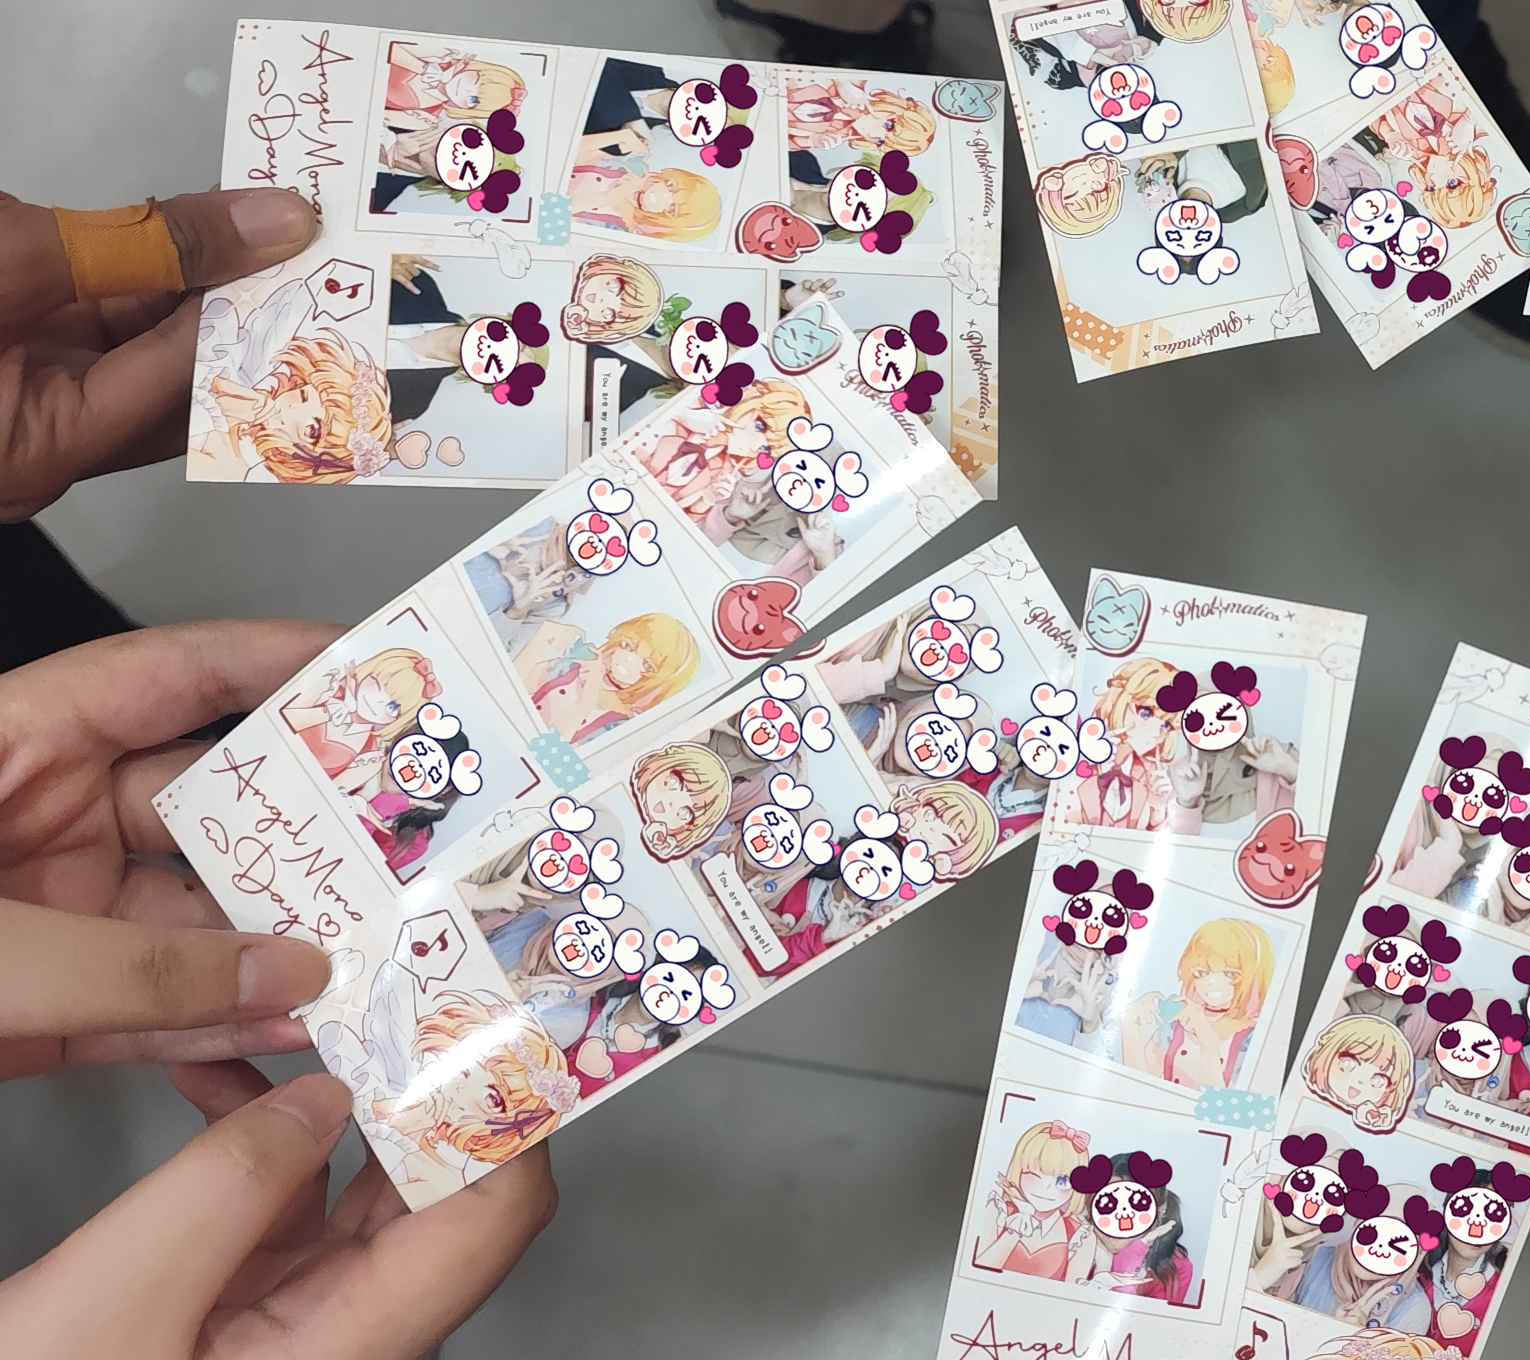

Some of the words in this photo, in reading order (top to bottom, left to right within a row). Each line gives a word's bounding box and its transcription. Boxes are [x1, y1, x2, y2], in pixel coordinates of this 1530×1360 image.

[299, 29, 354, 134] Angel
[248, 93, 303, 185] Day
[297, 128, 344, 224] Mona
[210, 747, 318, 845] Angel
[280, 847, 363, 921] Mona
[232, 836, 305, 936] Day
[1443, 1100, 1459, 1112] You
